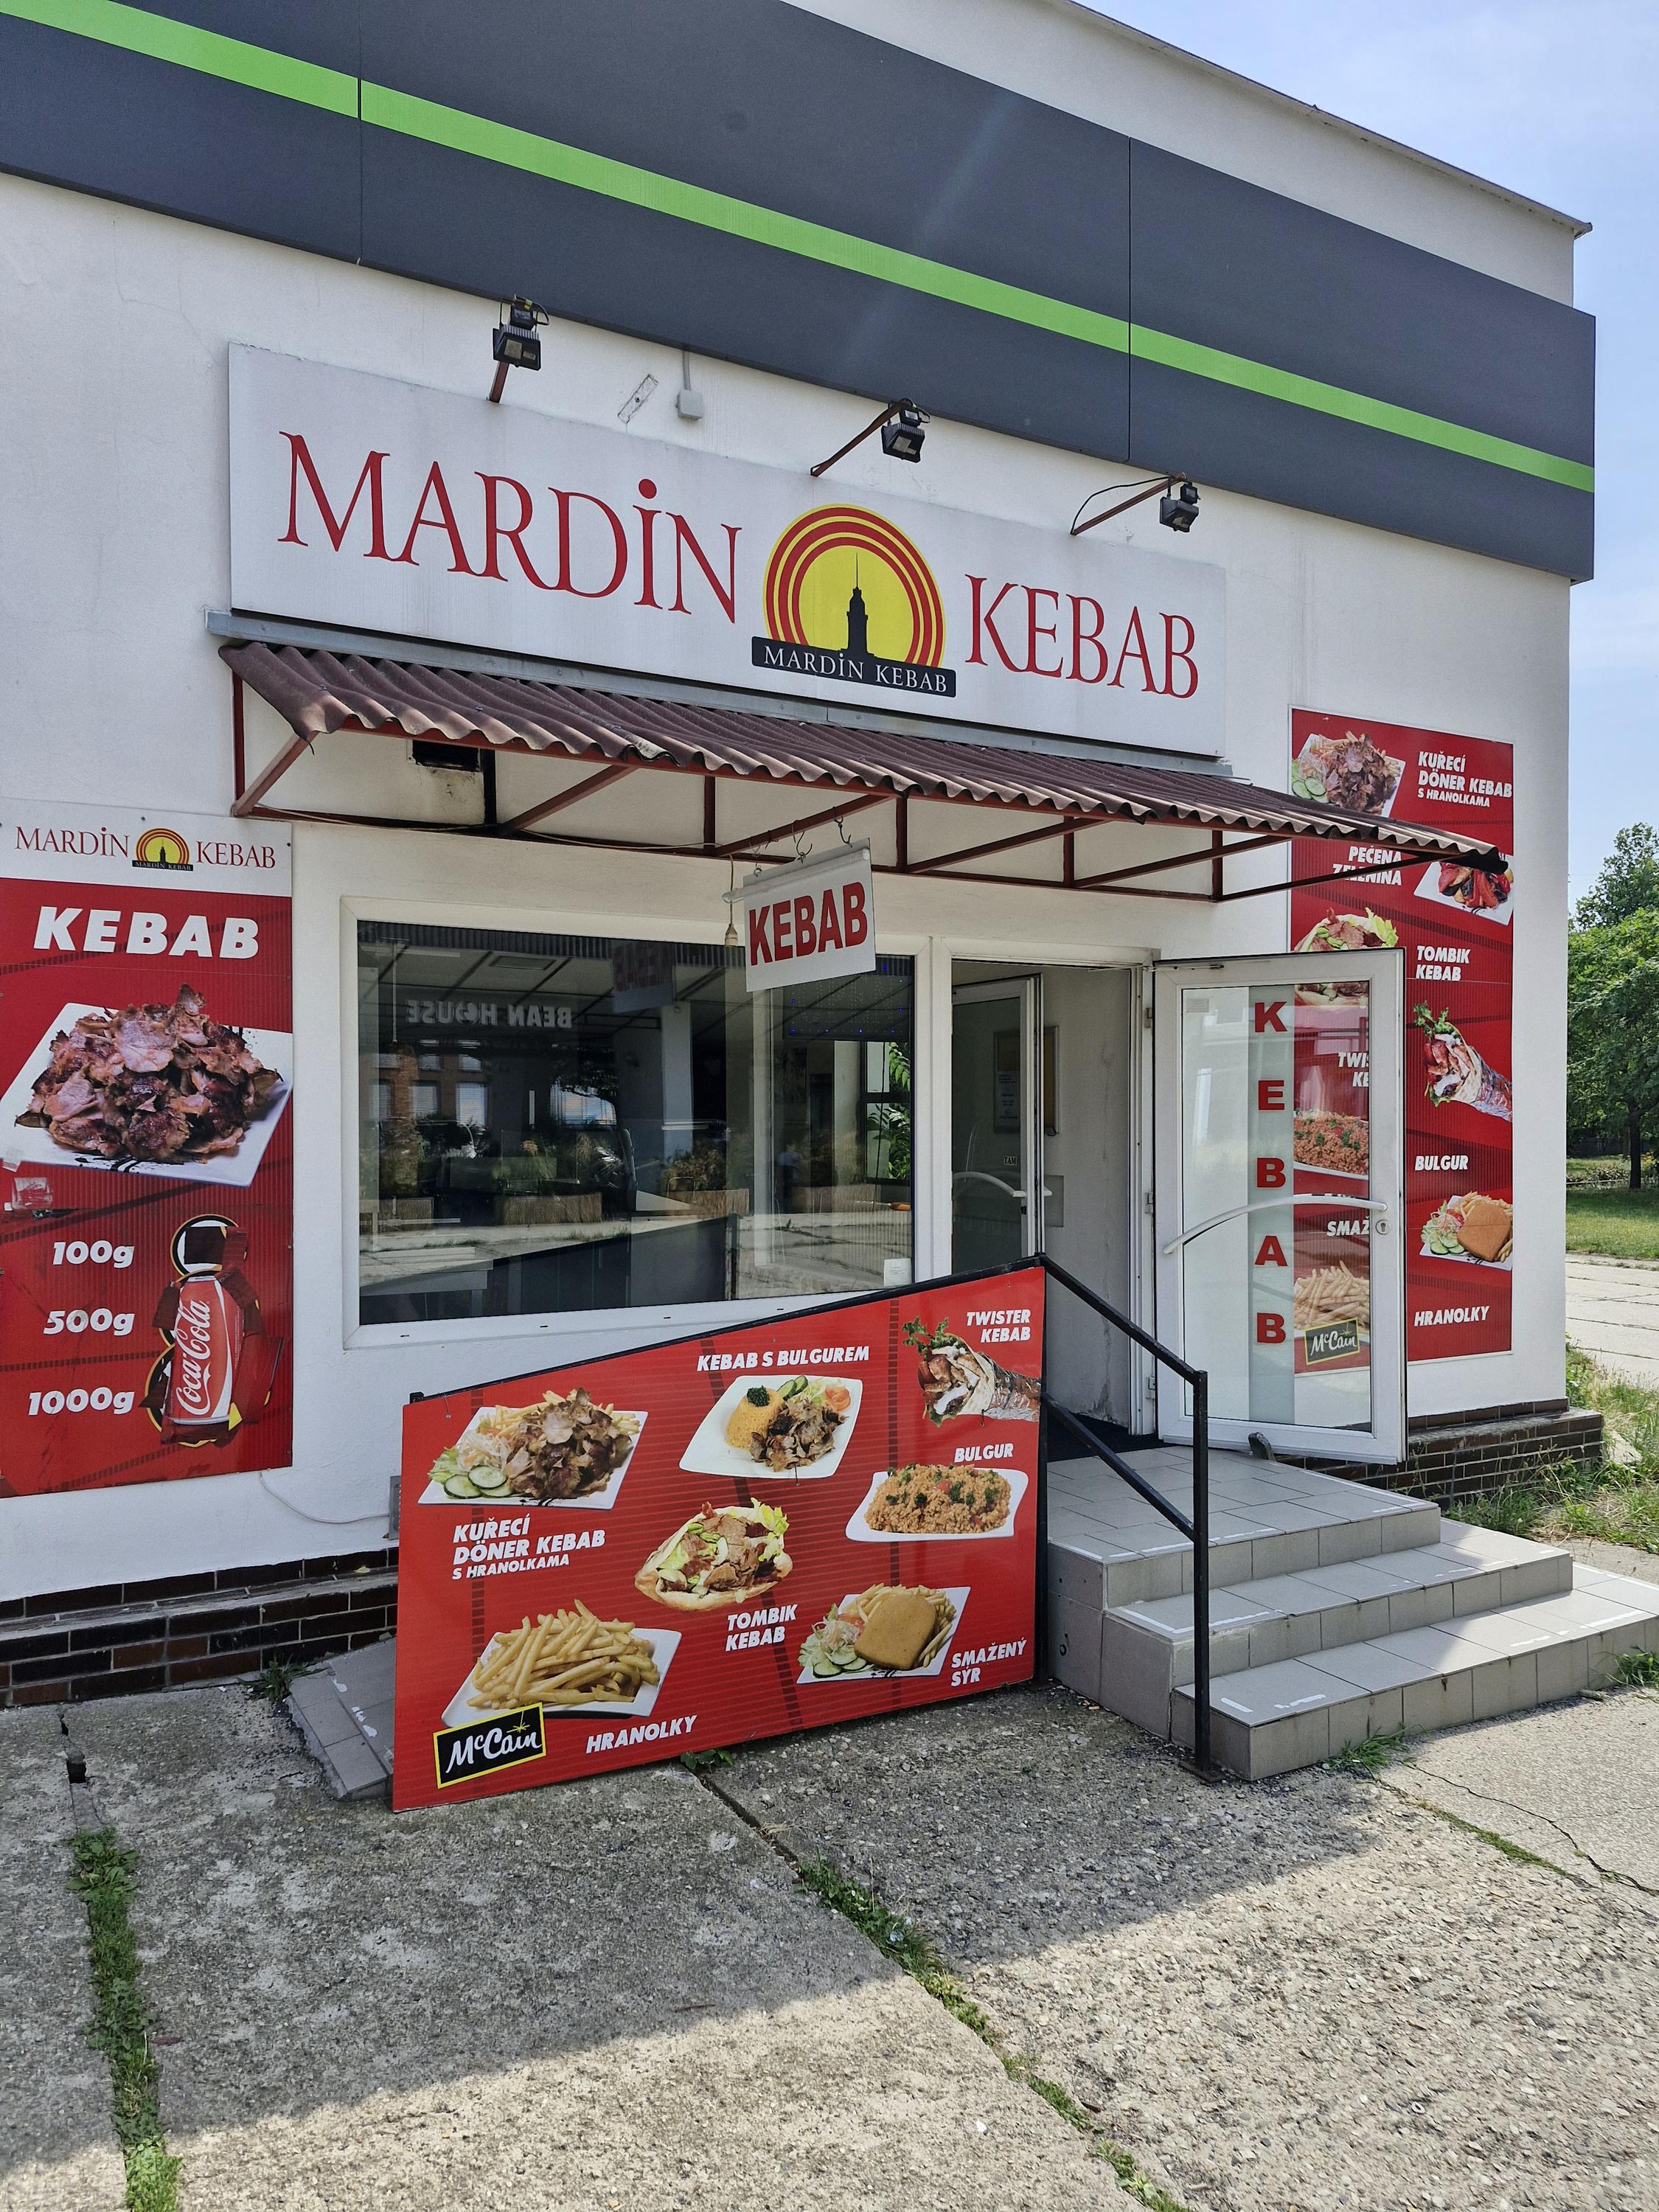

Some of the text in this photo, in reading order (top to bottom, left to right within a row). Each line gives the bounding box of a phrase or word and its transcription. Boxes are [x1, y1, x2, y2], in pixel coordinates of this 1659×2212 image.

[964, 574, 1198, 699] KEBAB
[875, 665, 947, 693] KEBAB
[1418, 751, 1466, 772] KUŘECÍ
[1418, 768, 1512, 798] DÖNER KEBAB
[1418, 788, 1490, 807] S HRANOLKAMA
[196, 841, 276, 869] KEBAB
[33, 905, 259, 959] KEBAB
[749, 882, 868, 967] KEBAB
[1417, 945, 1471, 964] TOMBIK
[1416, 964, 1461, 981] KEBAB
[1414, 1155, 1469, 1172] BULGUR
[1326, 1216, 1369, 1237] SMAŽ
[52, 1240, 135, 1268] 100g
[43, 1308, 135, 1335] 500g
[966, 1310, 1031, 1326] TWISTER
[1413, 1305, 1490, 1326] HRANOLKY
[980, 1326, 1030, 1343] KEBAB
[1310, 1330, 1358, 1357] McCain
[175, 1300, 211, 1415] Coca-Cola
[697, 1346, 870, 1372] KEBAB S BULGUREM
[28, 1386, 135, 1416] 1000g
[954, 1443, 1013, 1463] BULGUR
[453, 1513, 530, 1543] KUŘECÍ
[453, 1529, 606, 1565] DÖNER KEBAB
[452, 1554, 569, 1580] S HRANOLKAMA
[727, 1604, 798, 1631] TOMBIK
[725, 1628, 786, 1652] KEBAB
[950, 1639, 1026, 1669] SMAŽENÝ
[950, 1665, 981, 1687] SÝR
[585, 1714, 698, 1754] HRANOLKY
[445, 1728, 543, 1774] McCain
